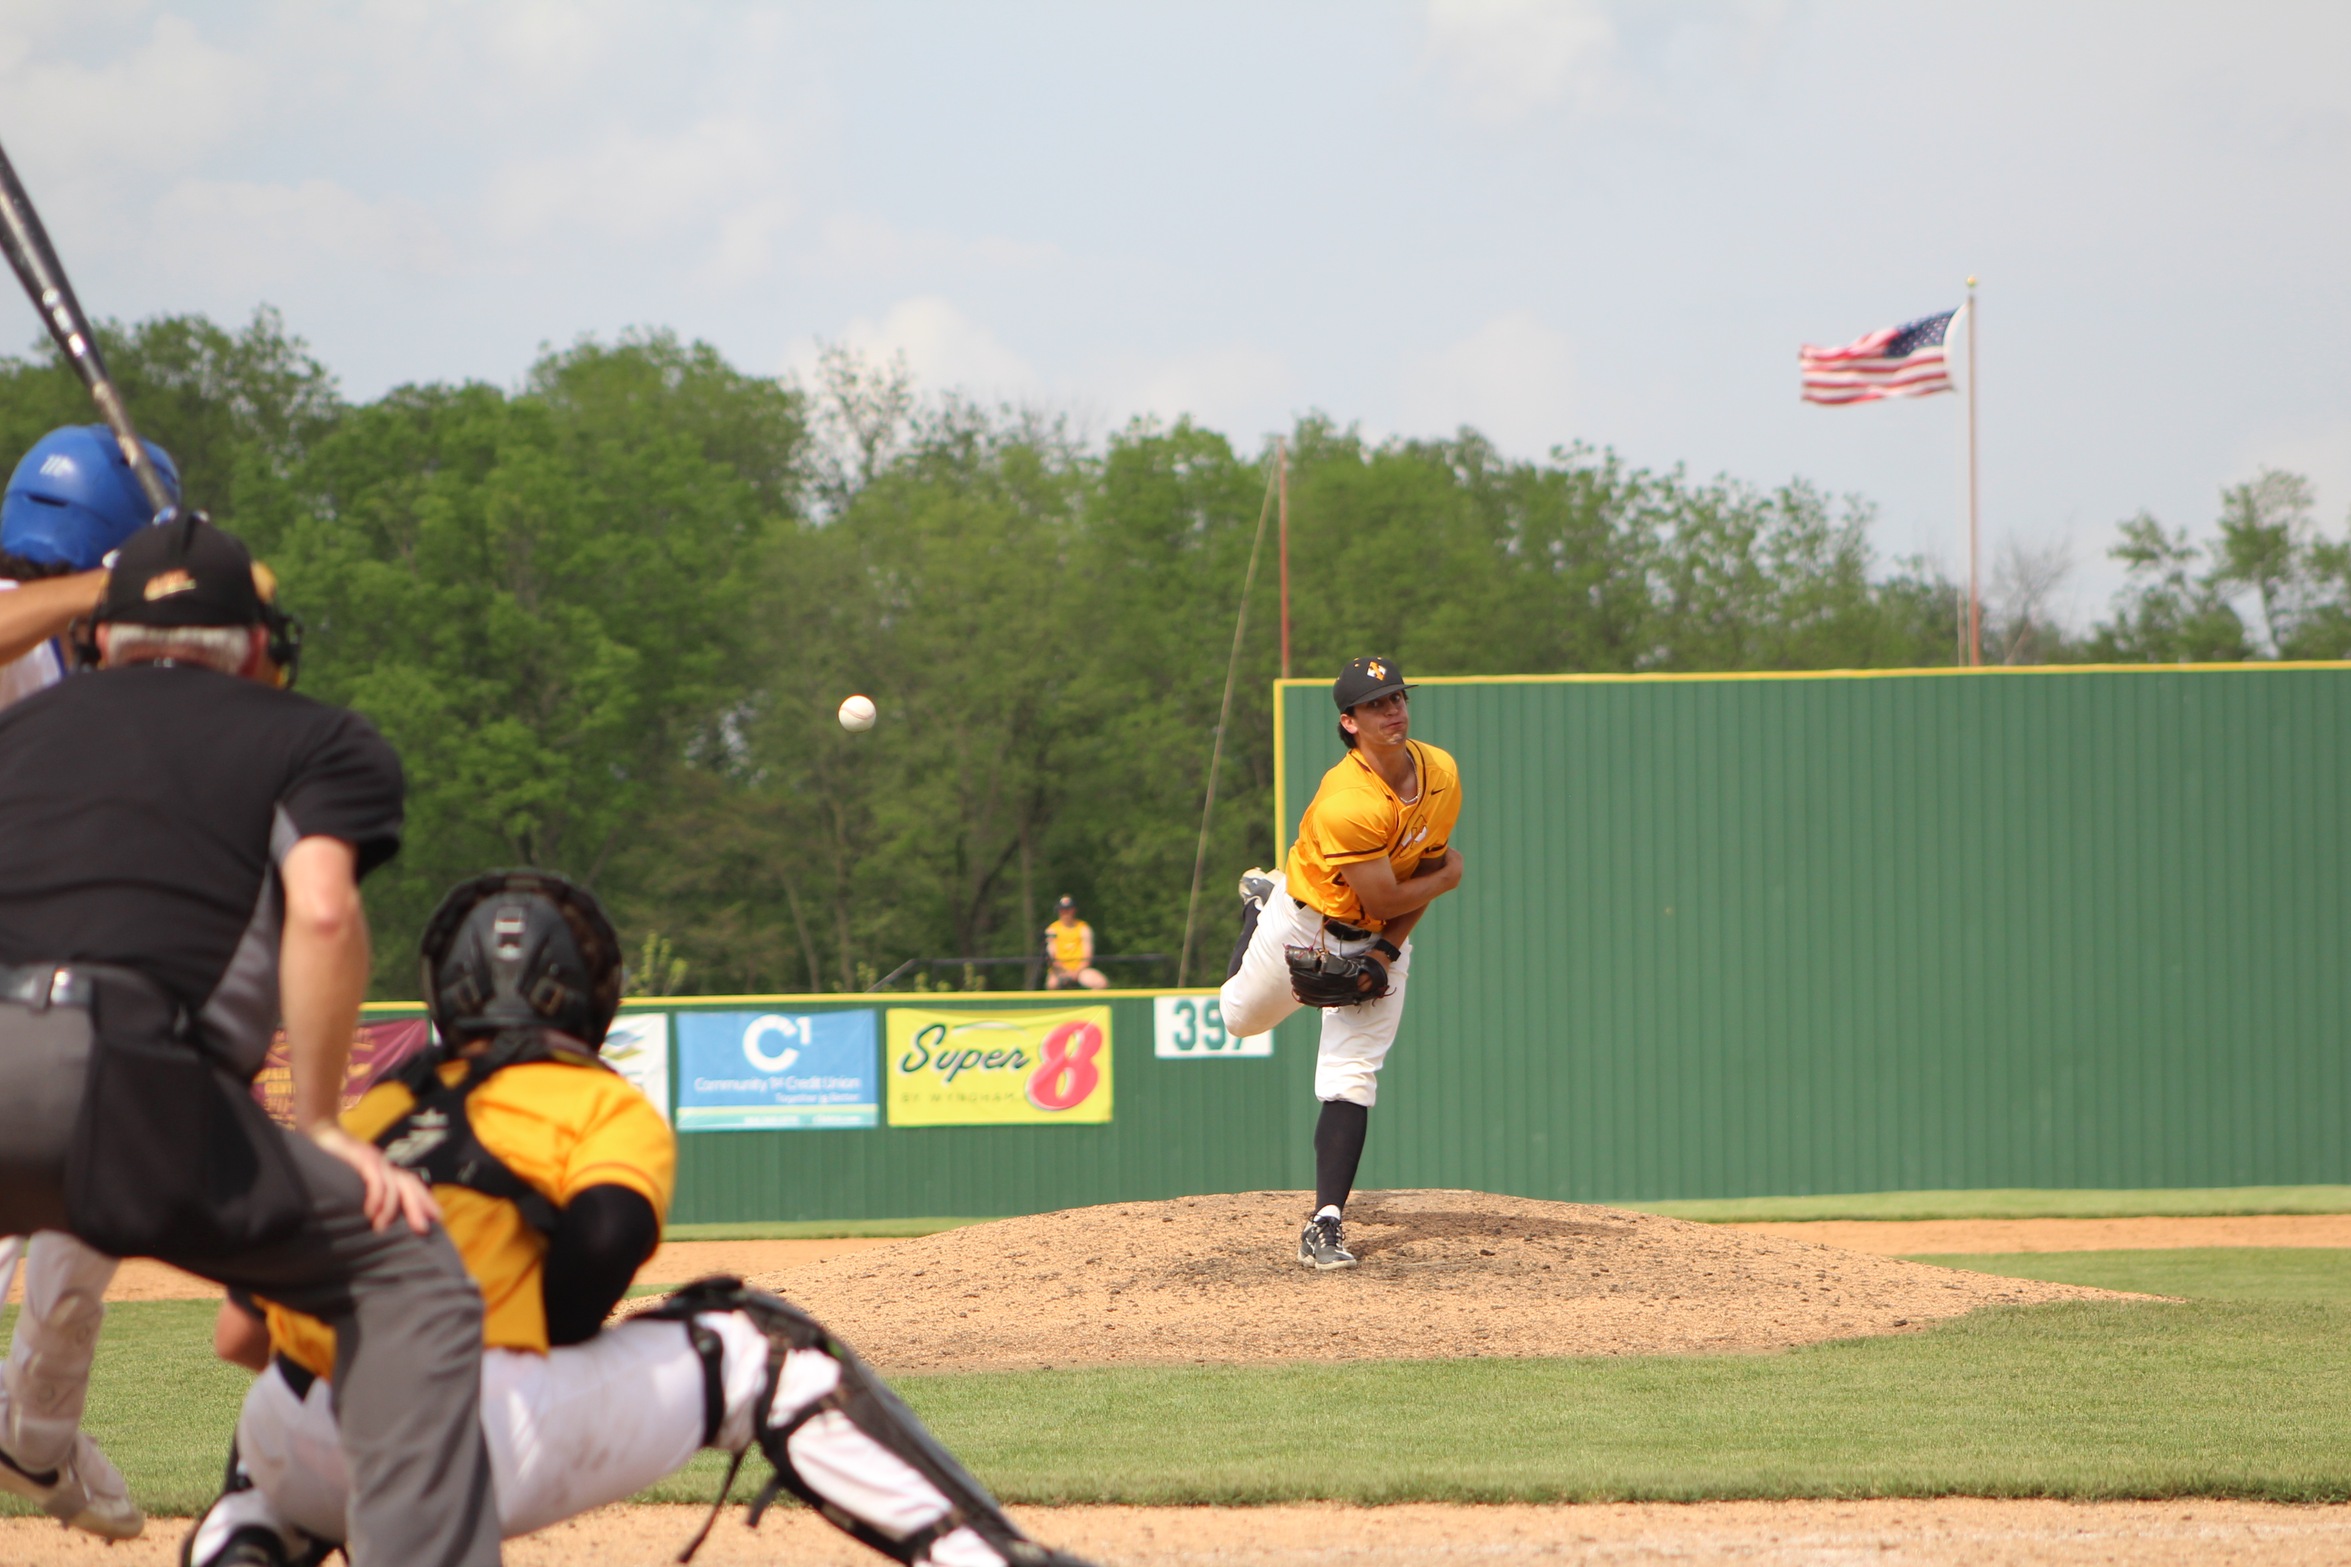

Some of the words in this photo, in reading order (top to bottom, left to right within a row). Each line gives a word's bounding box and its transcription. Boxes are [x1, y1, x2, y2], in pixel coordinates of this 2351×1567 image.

[1173, 999, 1244, 1051] 39
[694, 1077, 768, 1093] Community
[786, 1076, 821, 1090] Credit
[823, 1075, 861, 1089] Union
[900, 1023, 1031, 1083] Super
[1025, 1019, 1104, 1112] 8
